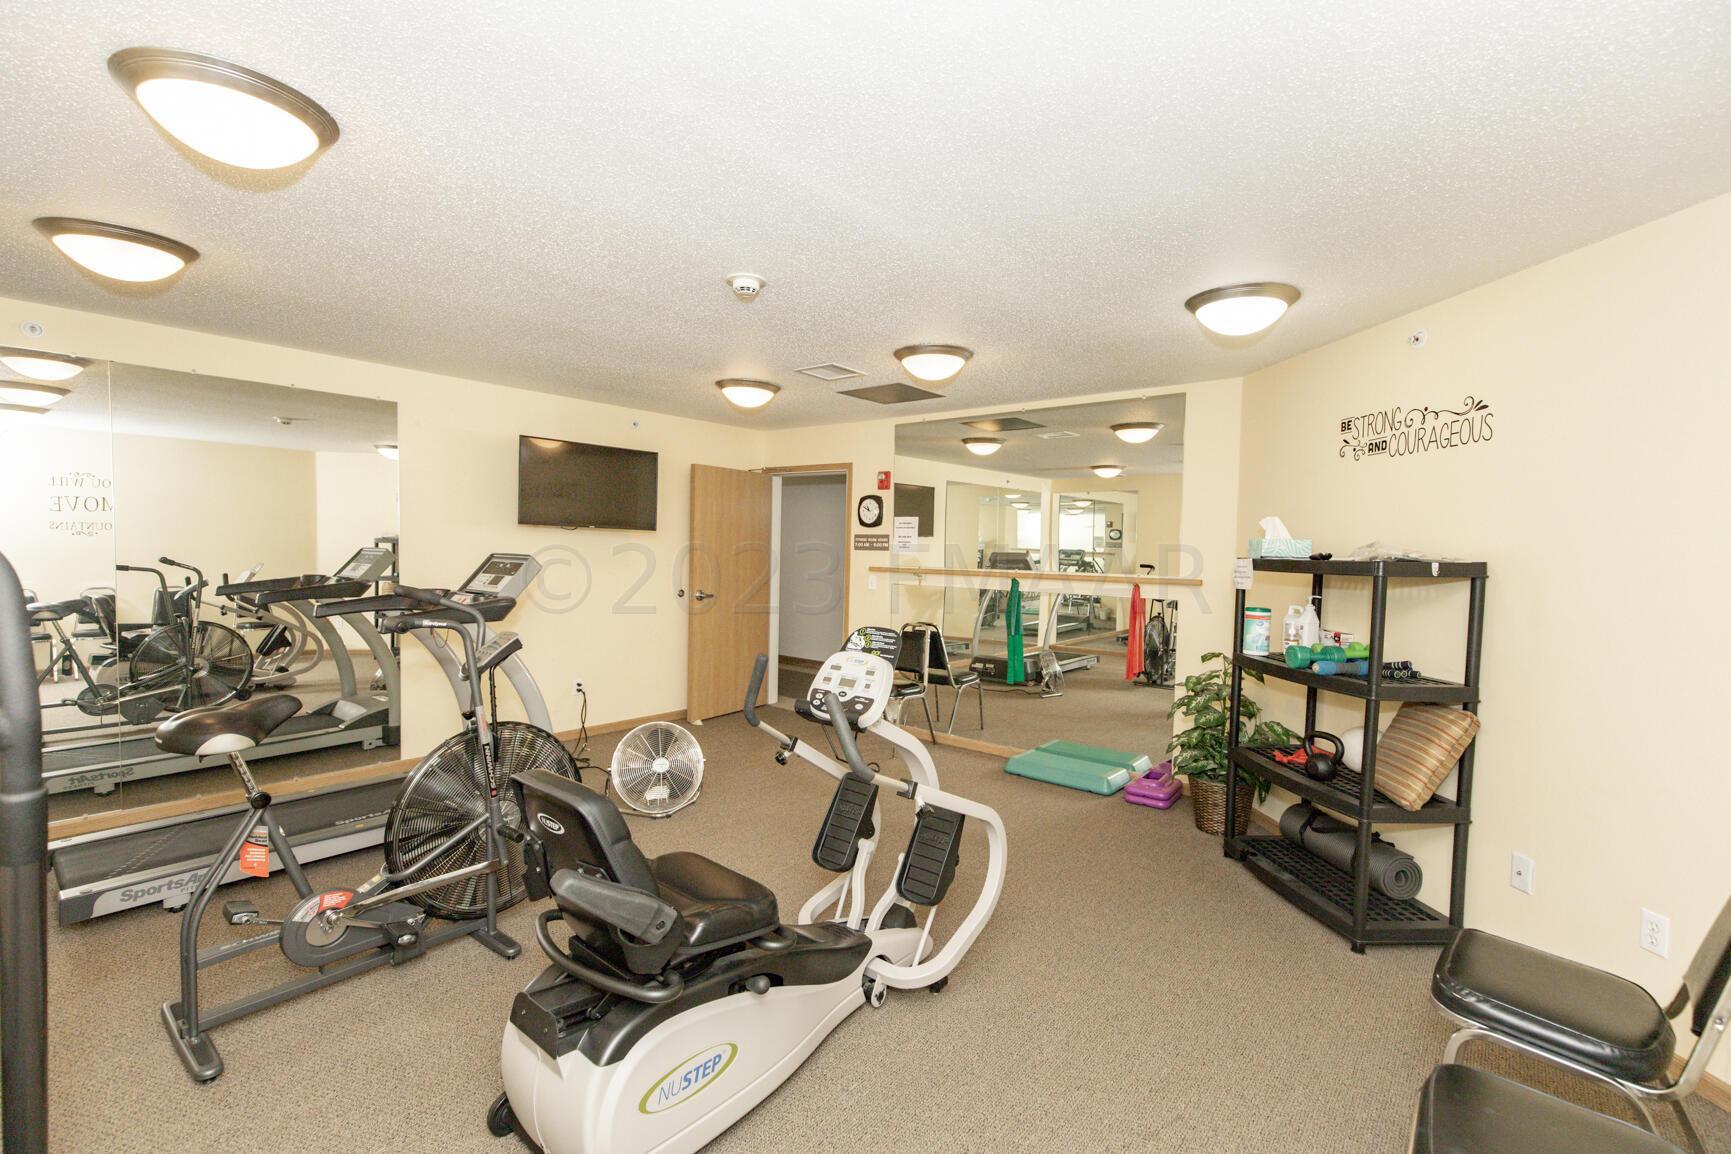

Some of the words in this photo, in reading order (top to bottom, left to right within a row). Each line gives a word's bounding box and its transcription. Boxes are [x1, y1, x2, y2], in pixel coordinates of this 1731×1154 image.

[1341, 420, 1353, 432] BE
[1352, 406, 1402, 440] STRONG
[1367, 440, 1387, 454] AND
[1388, 412, 1494, 458] COURAGEOUS
[658, 1053, 723, 1105] NUSTEP
